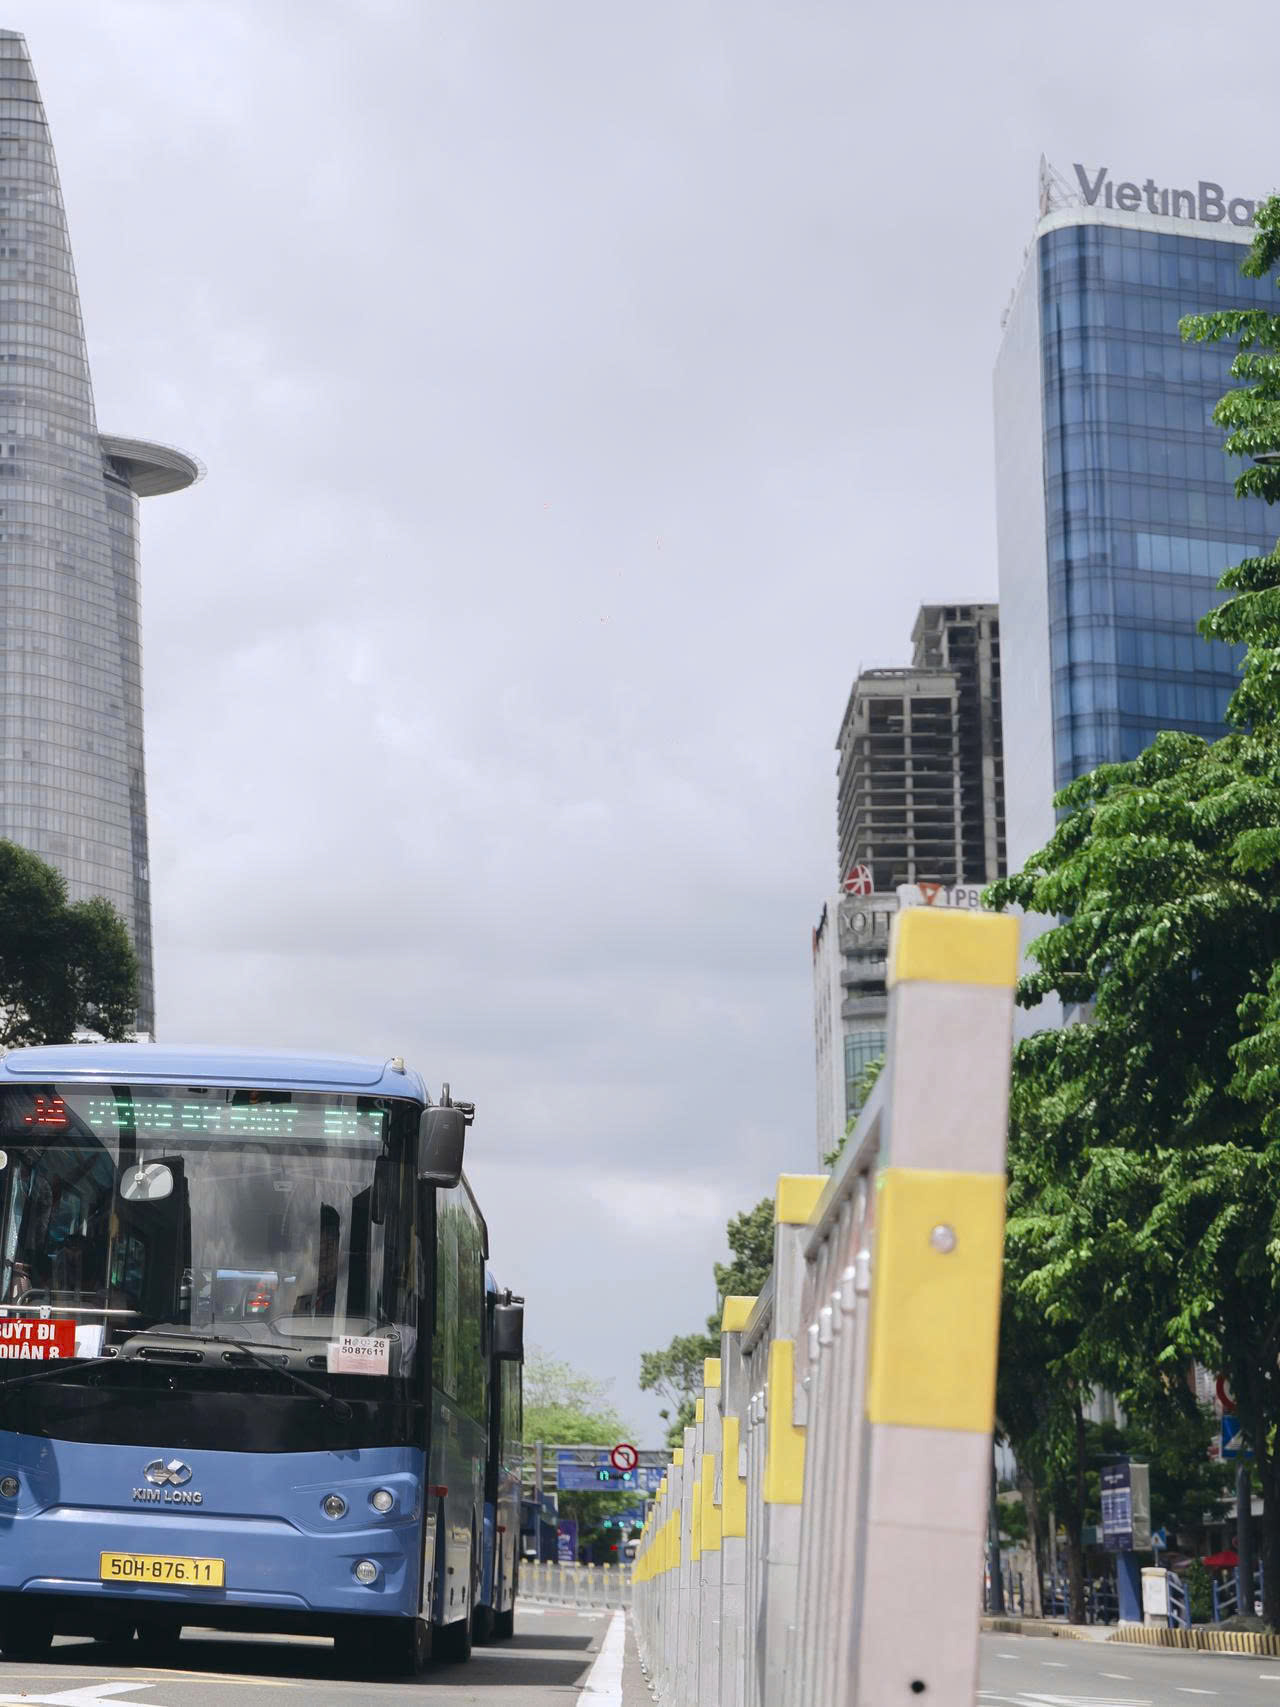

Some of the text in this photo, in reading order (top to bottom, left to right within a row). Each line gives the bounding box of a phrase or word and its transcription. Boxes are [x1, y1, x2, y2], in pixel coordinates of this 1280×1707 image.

[1073, 163, 1265, 228] VietinBa
[37, 1323, 56, 1341] ĐI
[133, 1488, 203, 1503] KIM LONG
[111, 1558, 211, 1580] 50H-876.11
